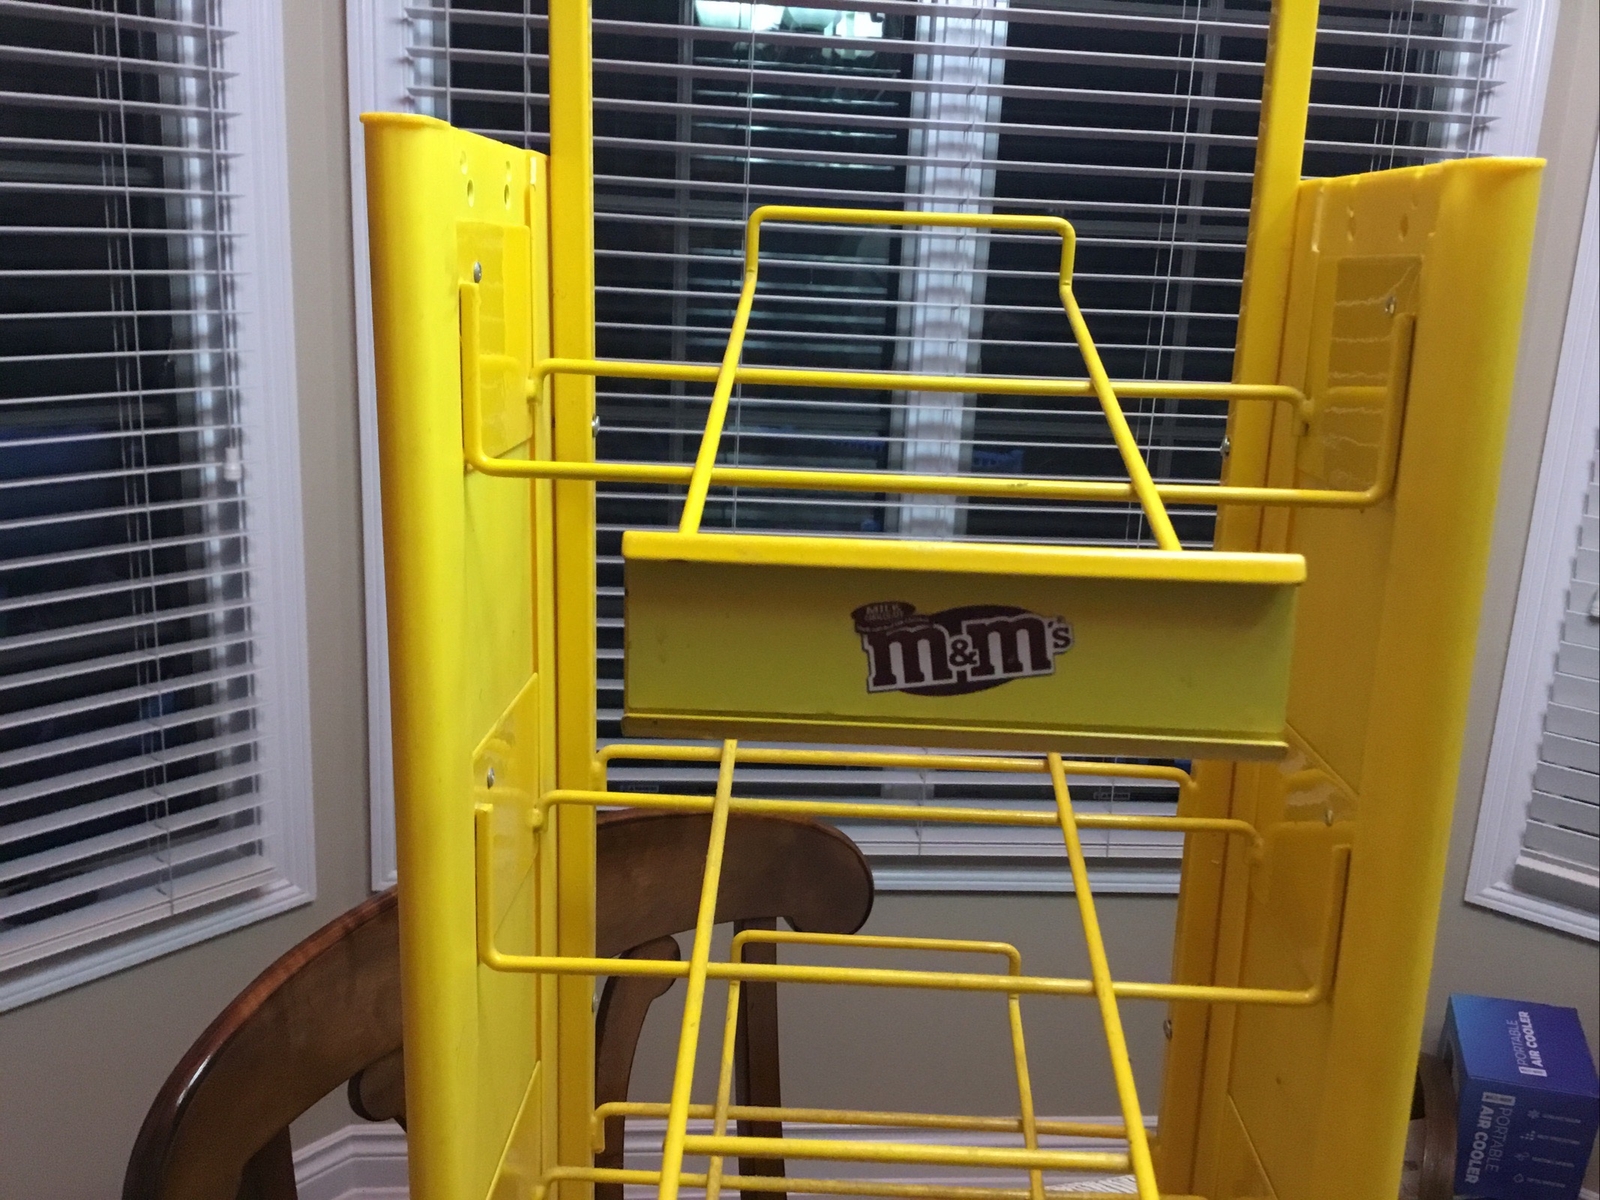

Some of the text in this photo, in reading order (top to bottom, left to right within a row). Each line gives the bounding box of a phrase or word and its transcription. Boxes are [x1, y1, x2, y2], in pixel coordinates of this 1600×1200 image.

[1506, 1019, 1528, 1067] PORTABLE
[1518, 1011, 1538, 1048] COOLER
[1529, 1050, 1544, 1067] AIR
[1464, 1105, 1494, 1184] AIR COOLER
[1485, 1107, 1514, 1172] PORTABLE
